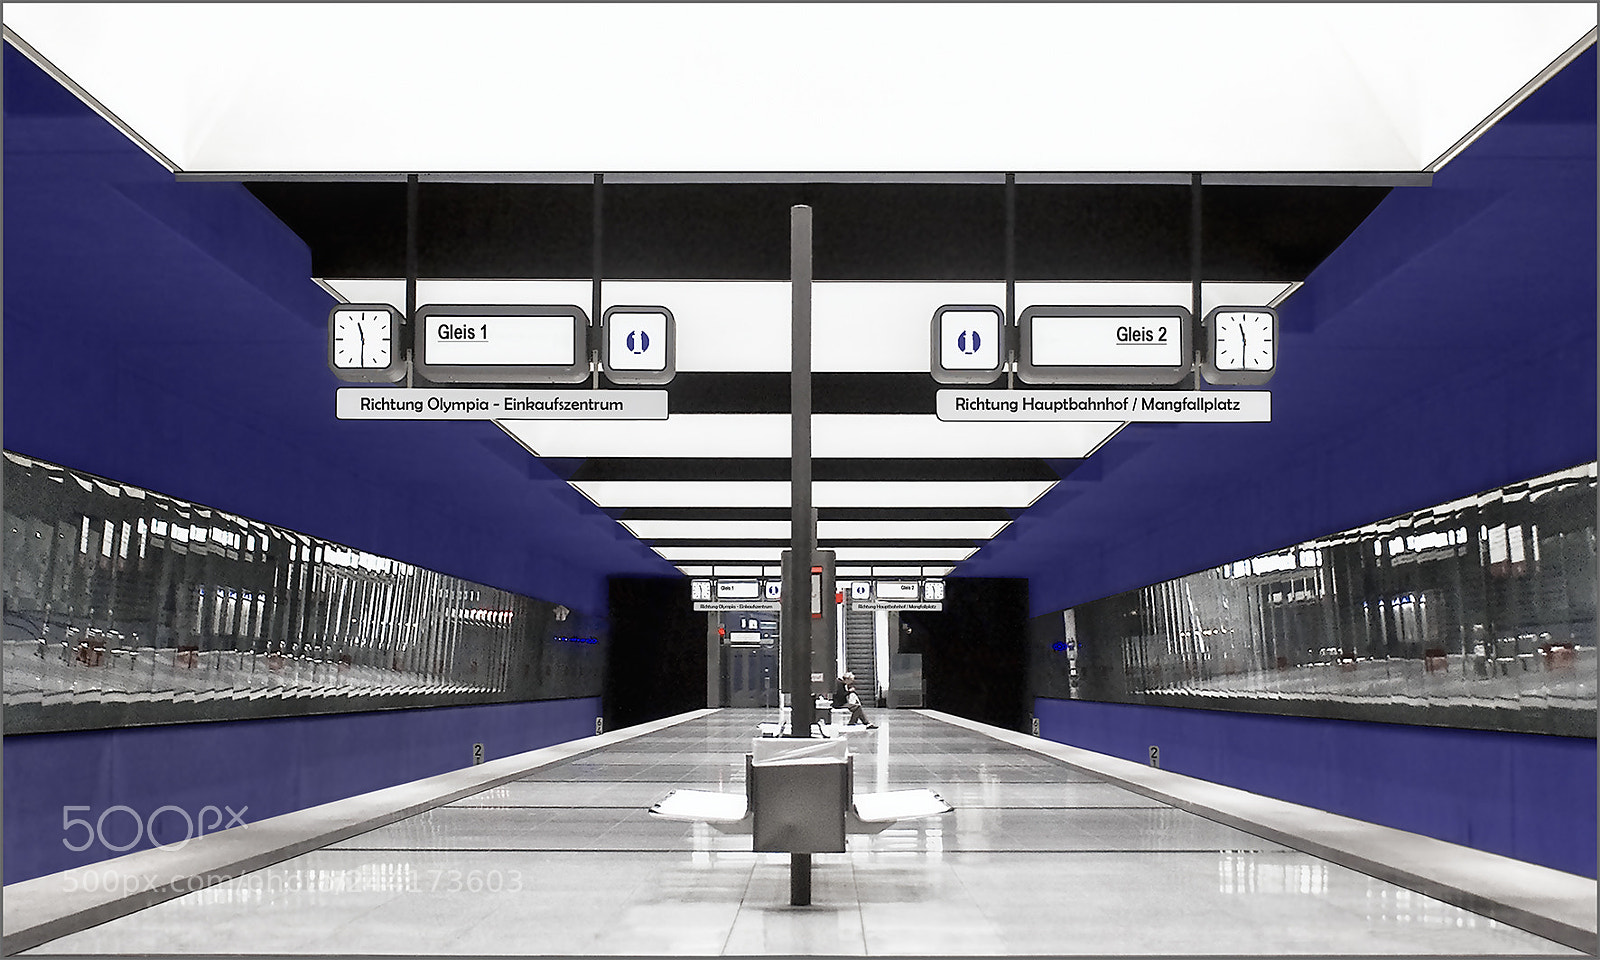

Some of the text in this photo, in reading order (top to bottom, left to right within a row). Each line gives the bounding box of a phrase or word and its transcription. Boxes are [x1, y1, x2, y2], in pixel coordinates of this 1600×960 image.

[437, 323, 488, 340] Gleis 1
[1116, 326, 1168, 342] Gleis 2
[360, 396, 424, 413] Richtung
[427, 396, 489, 413] Olympia
[504, 396, 624, 411] Einkaufszentrum
[955, 396, 1019, 413] Richtung
[1022, 396, 1129, 414] Hauptbahnhof
[1141, 396, 1241, 414] Mangfallplatz
